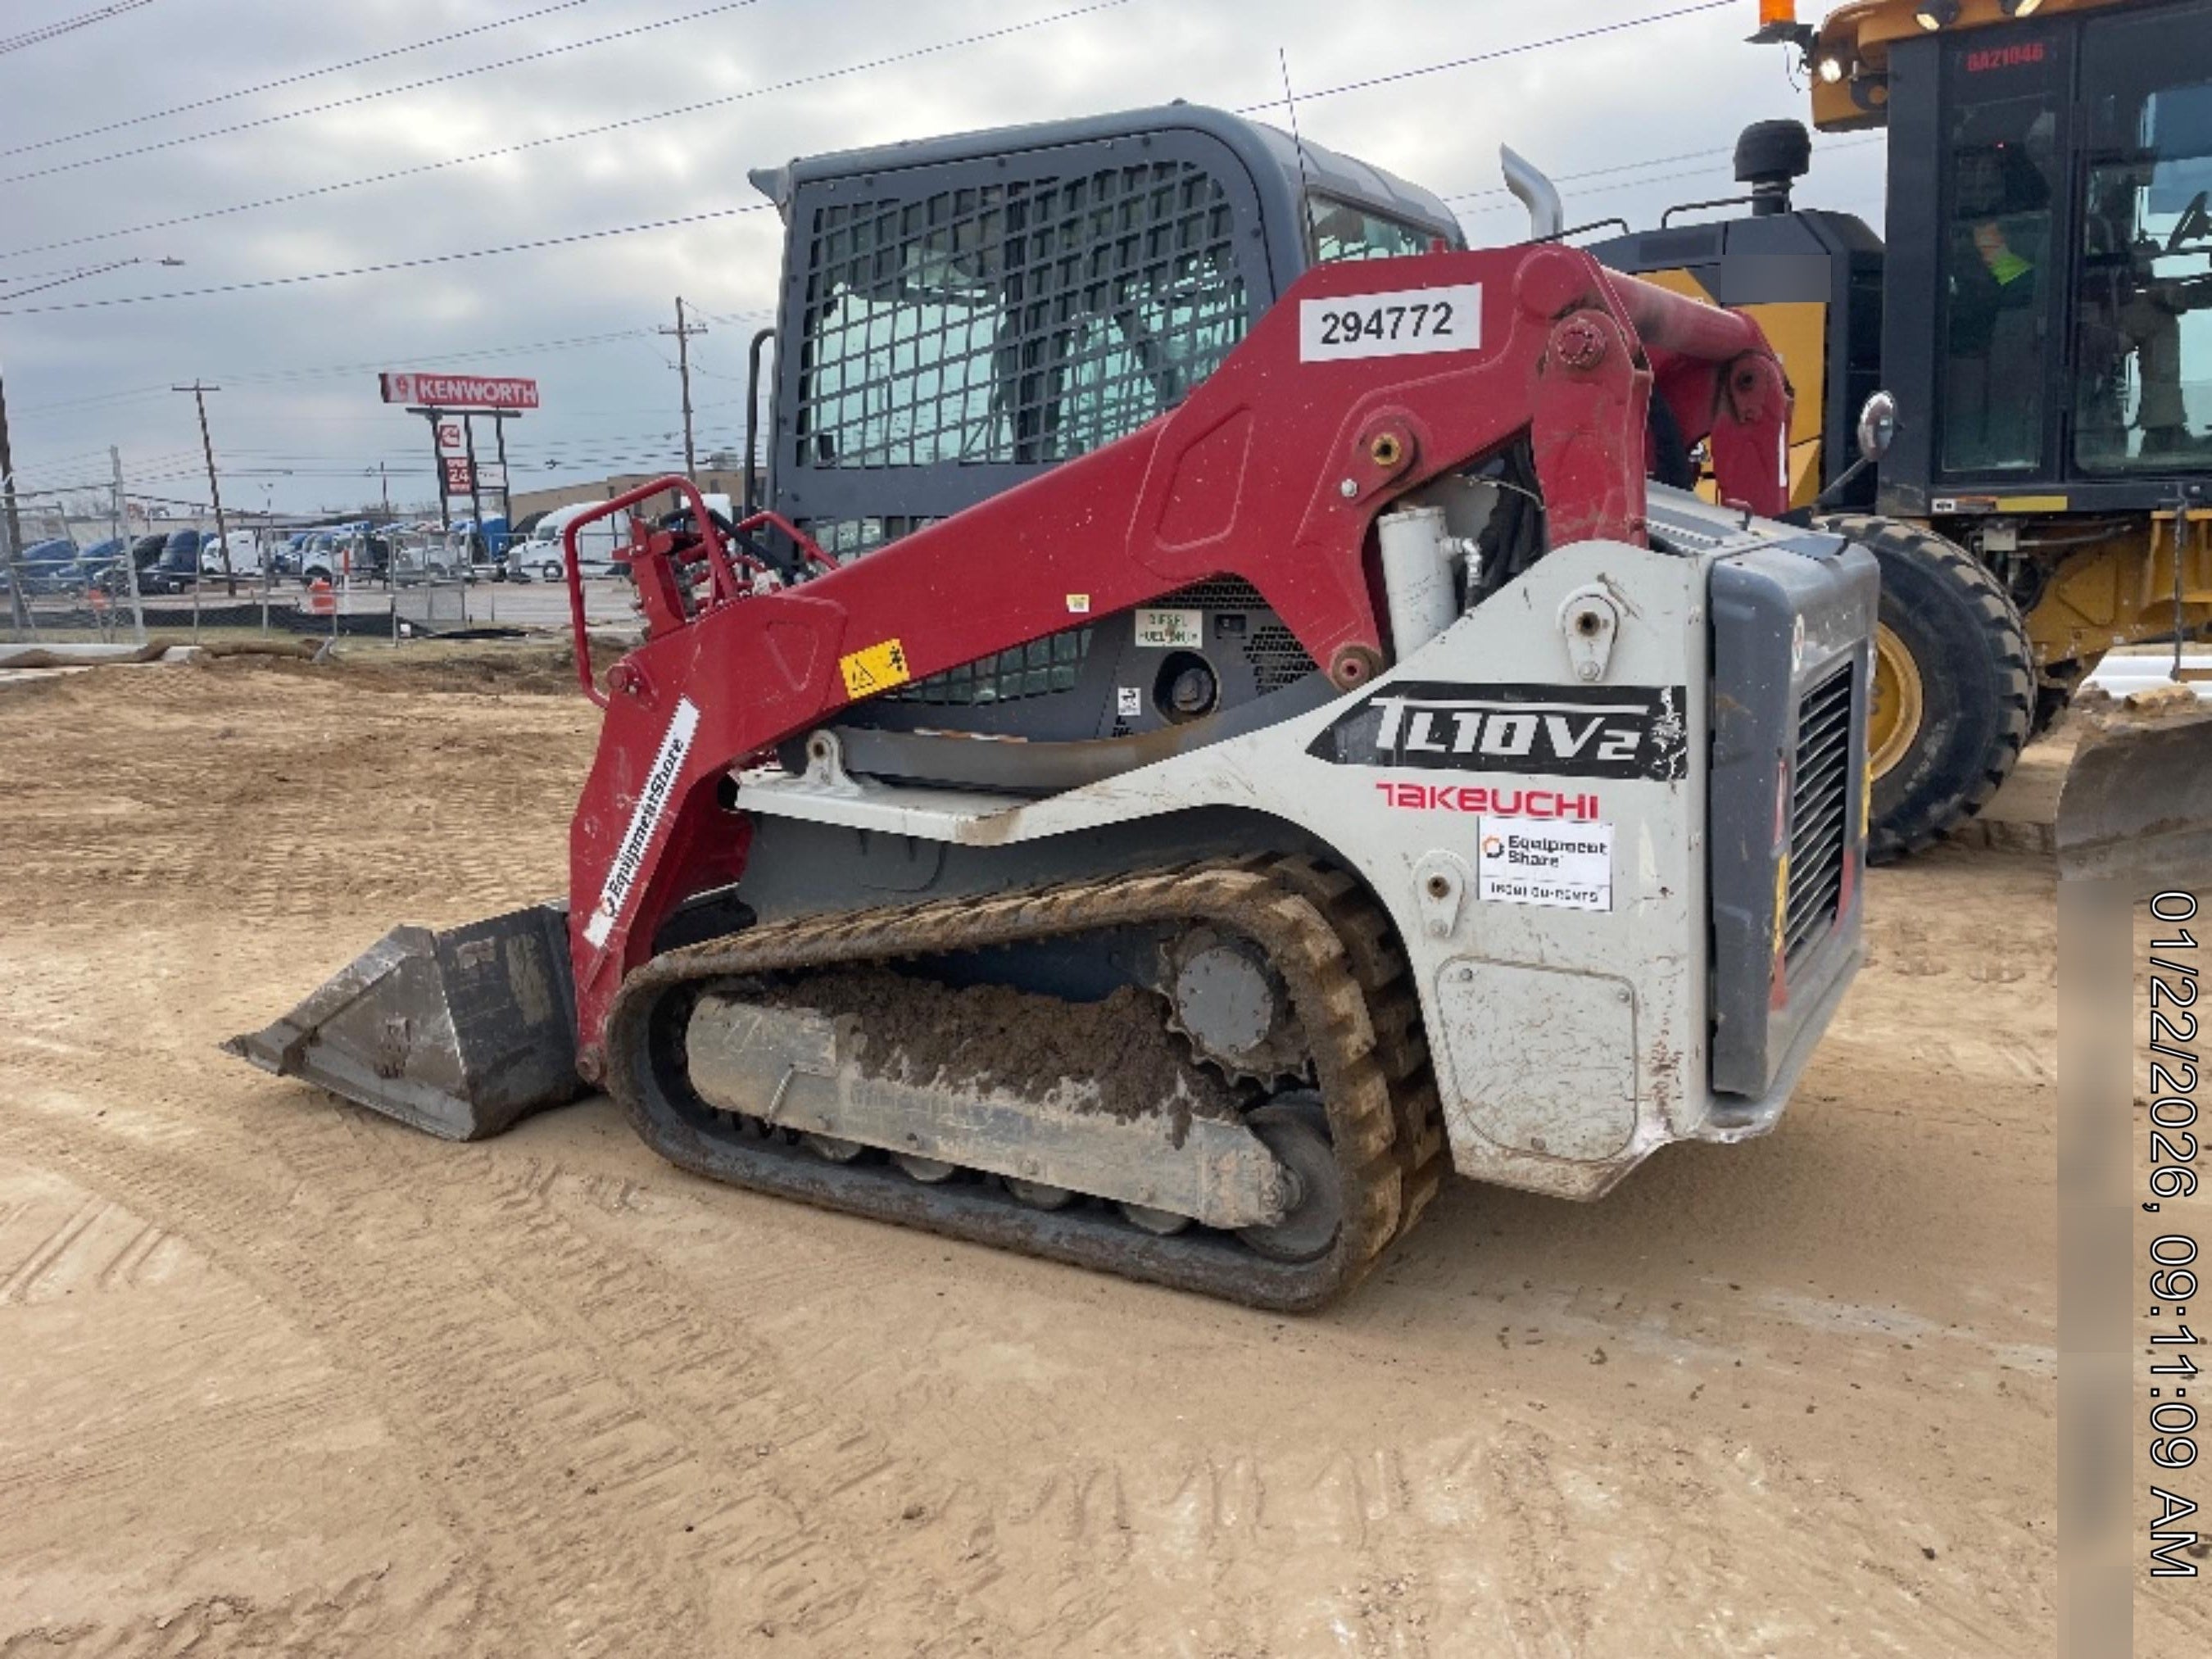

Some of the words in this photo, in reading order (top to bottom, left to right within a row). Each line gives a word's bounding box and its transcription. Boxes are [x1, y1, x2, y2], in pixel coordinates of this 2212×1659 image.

[1321, 301, 1453, 344] 294772
[419, 378, 537, 404] KENWORTH
[448, 469, 469, 483] 24
[1368, 697, 1650, 760] TL10V2
[1508, 834, 1608, 855] Equipment
[1508, 850, 1559, 868] Share
